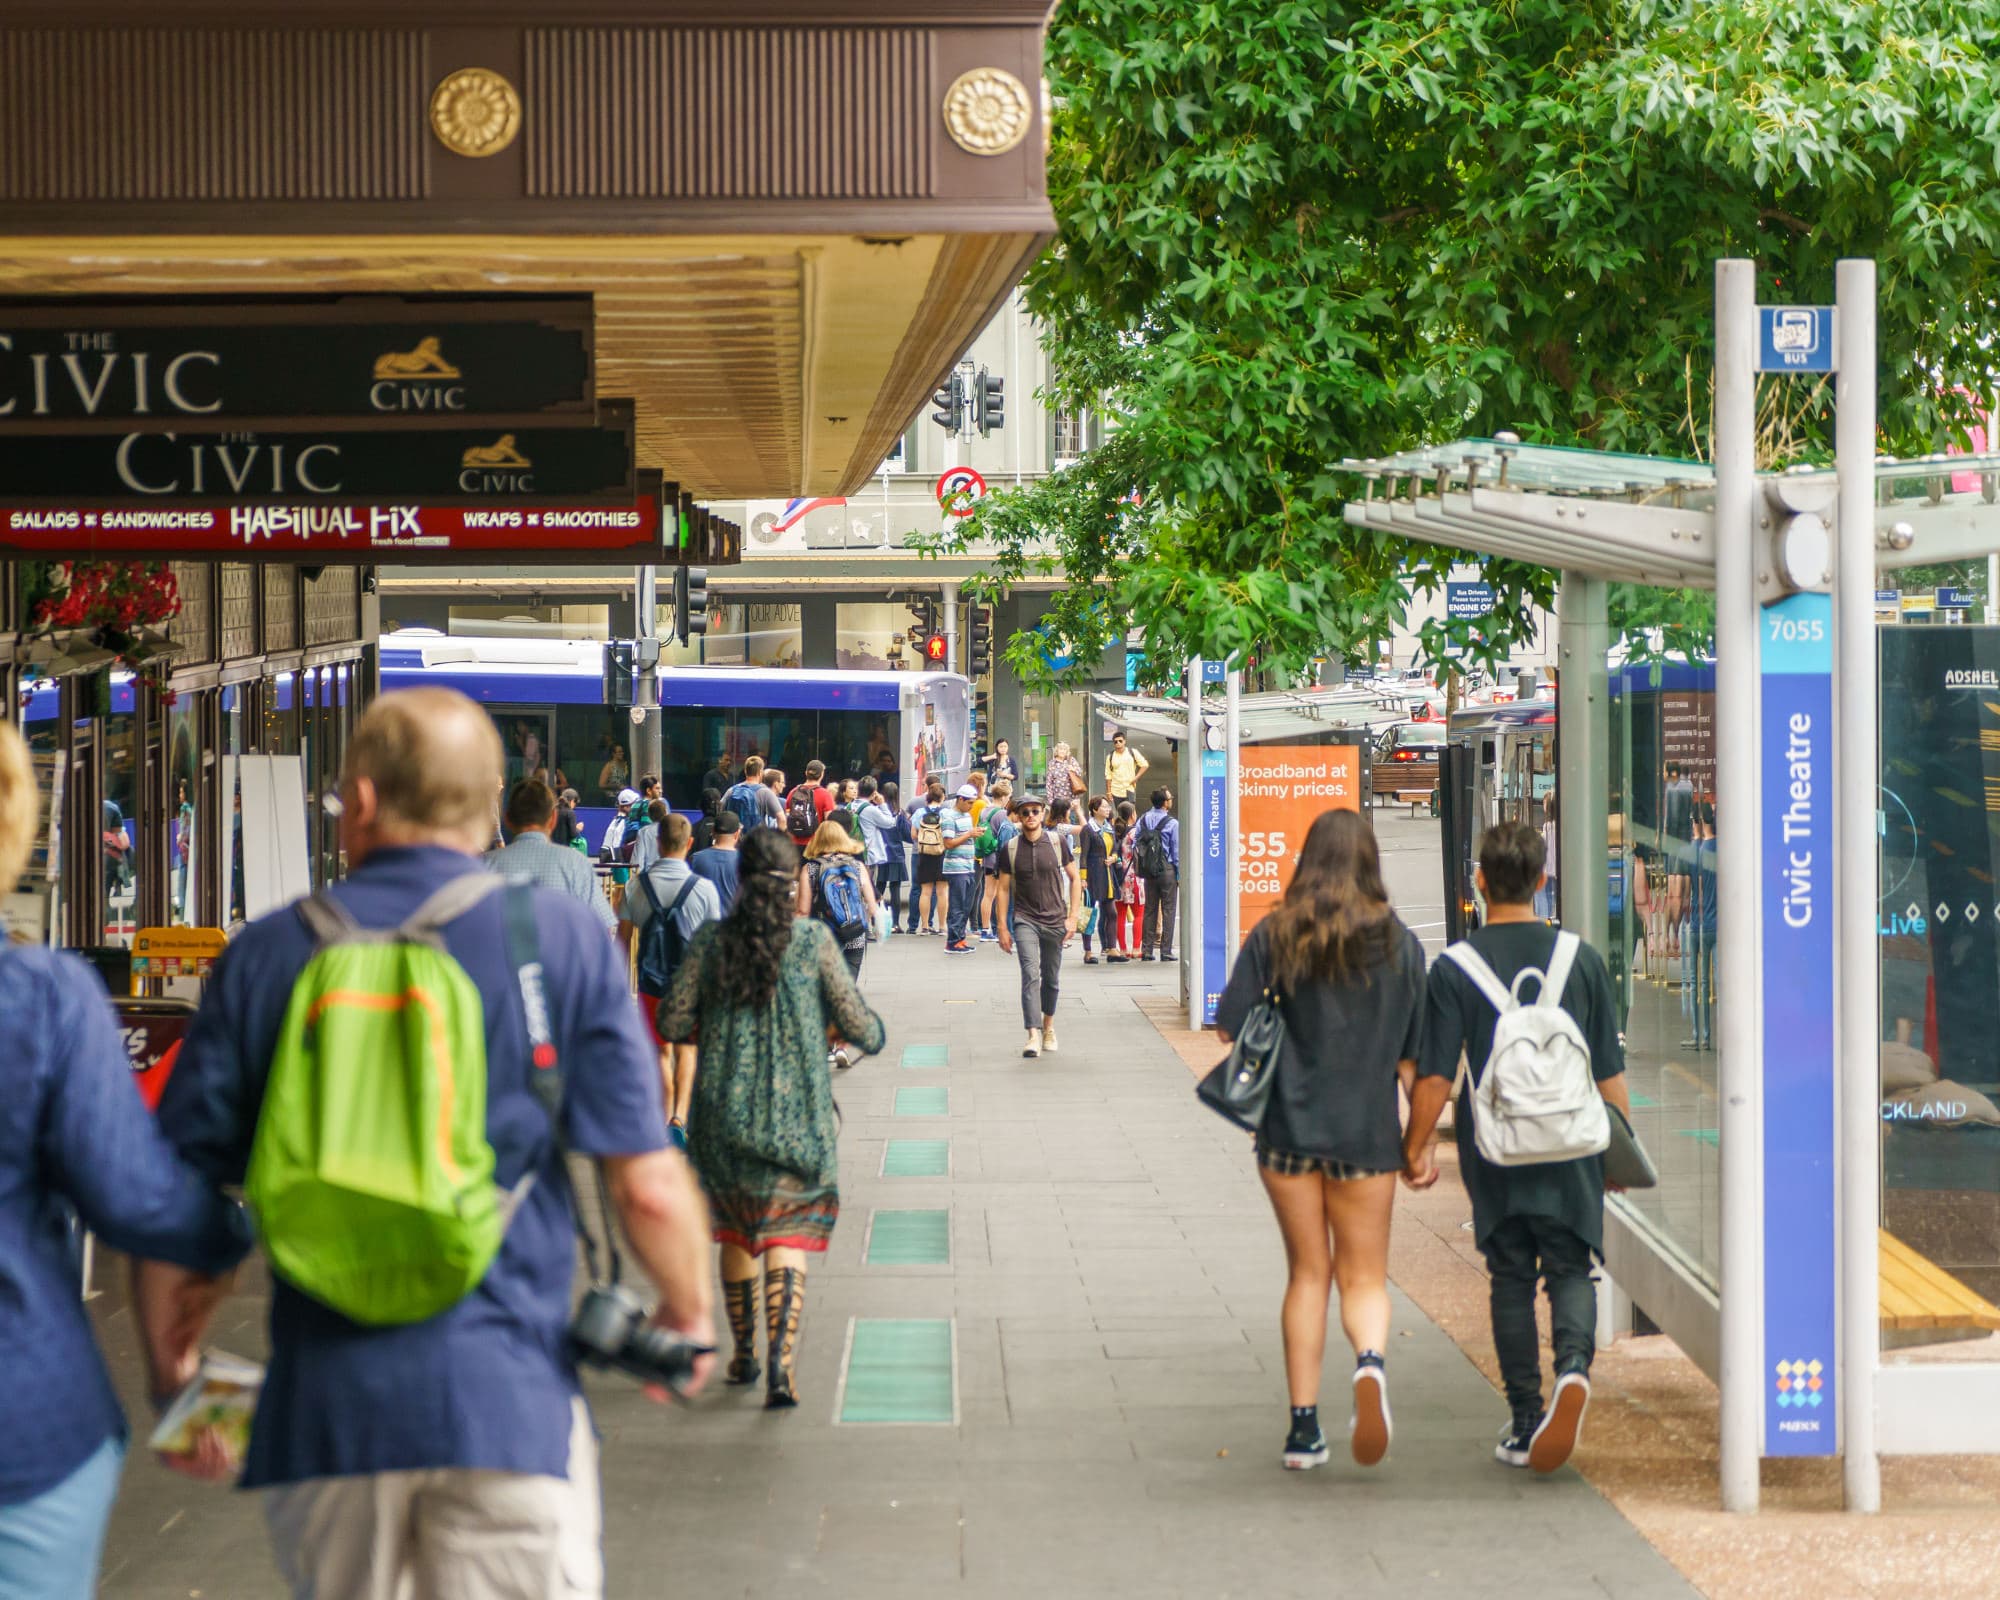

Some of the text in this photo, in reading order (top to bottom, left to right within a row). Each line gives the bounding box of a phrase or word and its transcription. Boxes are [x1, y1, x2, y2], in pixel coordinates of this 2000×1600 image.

[64, 333, 115, 351] THE
[1784, 353, 1808, 364] BUS
[0, 335, 223, 415] IVIC
[10, 512, 80, 529] SALADS
[101, 512, 214, 529] SANDWICHES
[463, 511, 522, 528] WRAPS
[543, 511, 640, 528] SMOOTHIES
[1769, 620, 1824, 641] 7055
[1207, 665, 1220, 673] C2
[1945, 670, 1999, 684] ADSHEL
[1205, 759, 1223, 767] 7055
[1331, 764, 1348, 778] at
[1293, 782, 1347, 798] prices.
[1209, 789, 1220, 857] Civic Theatre
[1782, 713, 1813, 928] Civic Theatre
[1879, 1100, 1967, 1120] CKLAND
